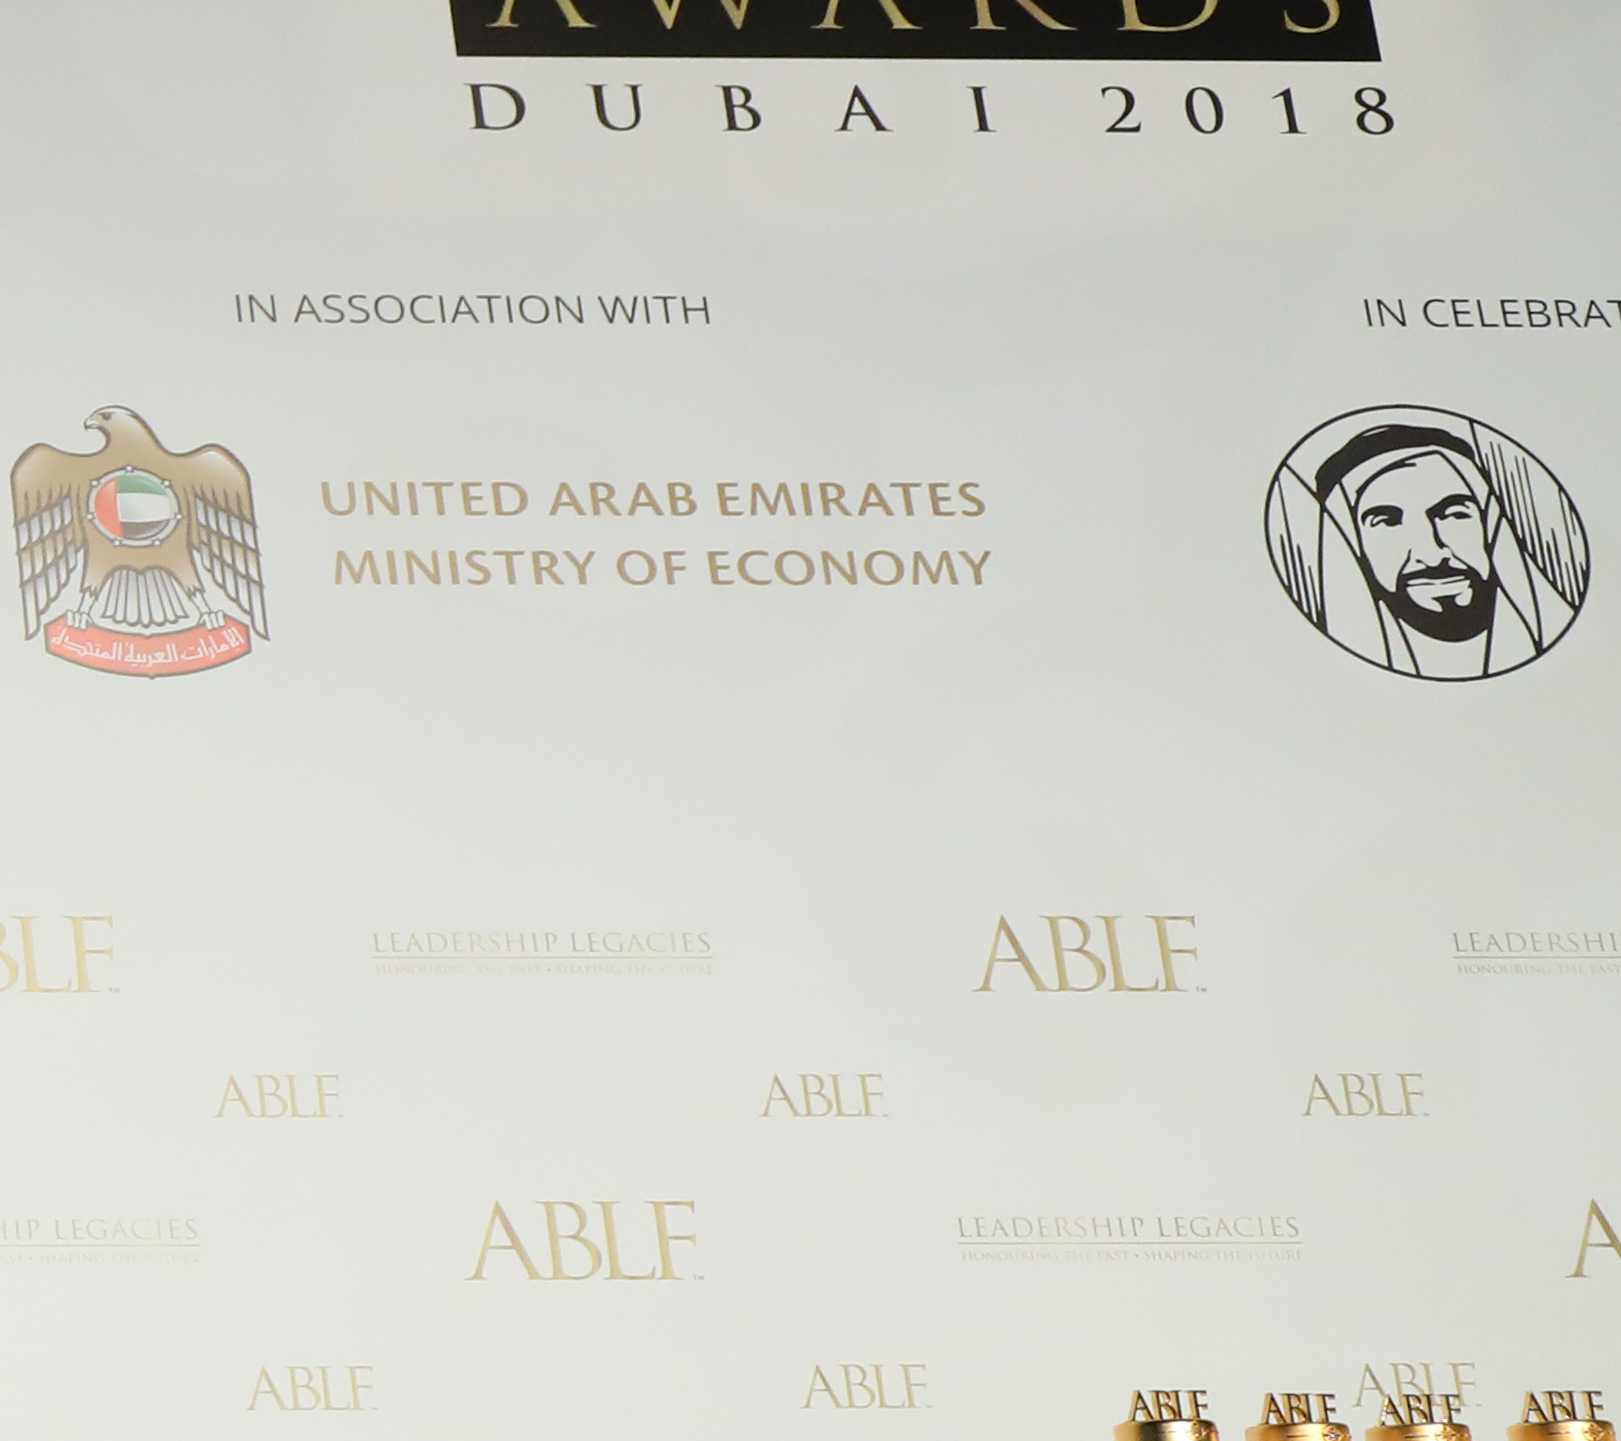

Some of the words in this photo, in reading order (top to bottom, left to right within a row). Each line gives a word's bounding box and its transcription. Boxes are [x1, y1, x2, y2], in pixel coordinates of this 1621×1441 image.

[470, 83, 994, 135] DUBAI
[1102, 84, 1397, 139] 2018
[234, 294, 280, 325] IN
[294, 294, 588, 326] ASSOCIATION
[600, 295, 711, 326] WITH
[1364, 299, 1407, 327] IN
[320, 480, 528, 517] UNITED
[548, 482, 698, 518] ARAB
[716, 482, 988, 518] EMIRATES
[333, 550, 597, 587] MINISTRY
[616, 551, 690, 587] OF
[709, 551, 993, 588] ECONOMY
[373, 932, 557, 953] LEADERSHIP
[570, 932, 711, 953] LEGACIES
[973, 915, 1197, 992] ABLF
[1451, 932, 1621, 953] LEADERSHI
[215, 1074, 339, 1118] ABLF
[760, 1074, 883, 1117] ABLF
[1302, 1073, 1423, 1116] ABLF
[53, 1218, 198, 1241] LEGACIES
[466, 1200, 696, 1280] ABLF
[957, 1216, 1144, 1238] LEADERSHIP
[1156, 1216, 1299, 1238] LEGACIES
[962, 1250, 1058, 1261] HONOURING
[1144, 1250, 1209, 1261] SHAPING
[247, 1366, 372, 1411] ABLF
[803, 1364, 926, 1409] ABLF
[1128, 1389, 1208, 1422] ABLF
[1260, 1392, 1337, 1425] ABLF
[1379, 1393, 1462, 1426] ABLF
[1524, 1390, 1605, 1423] ABLF
